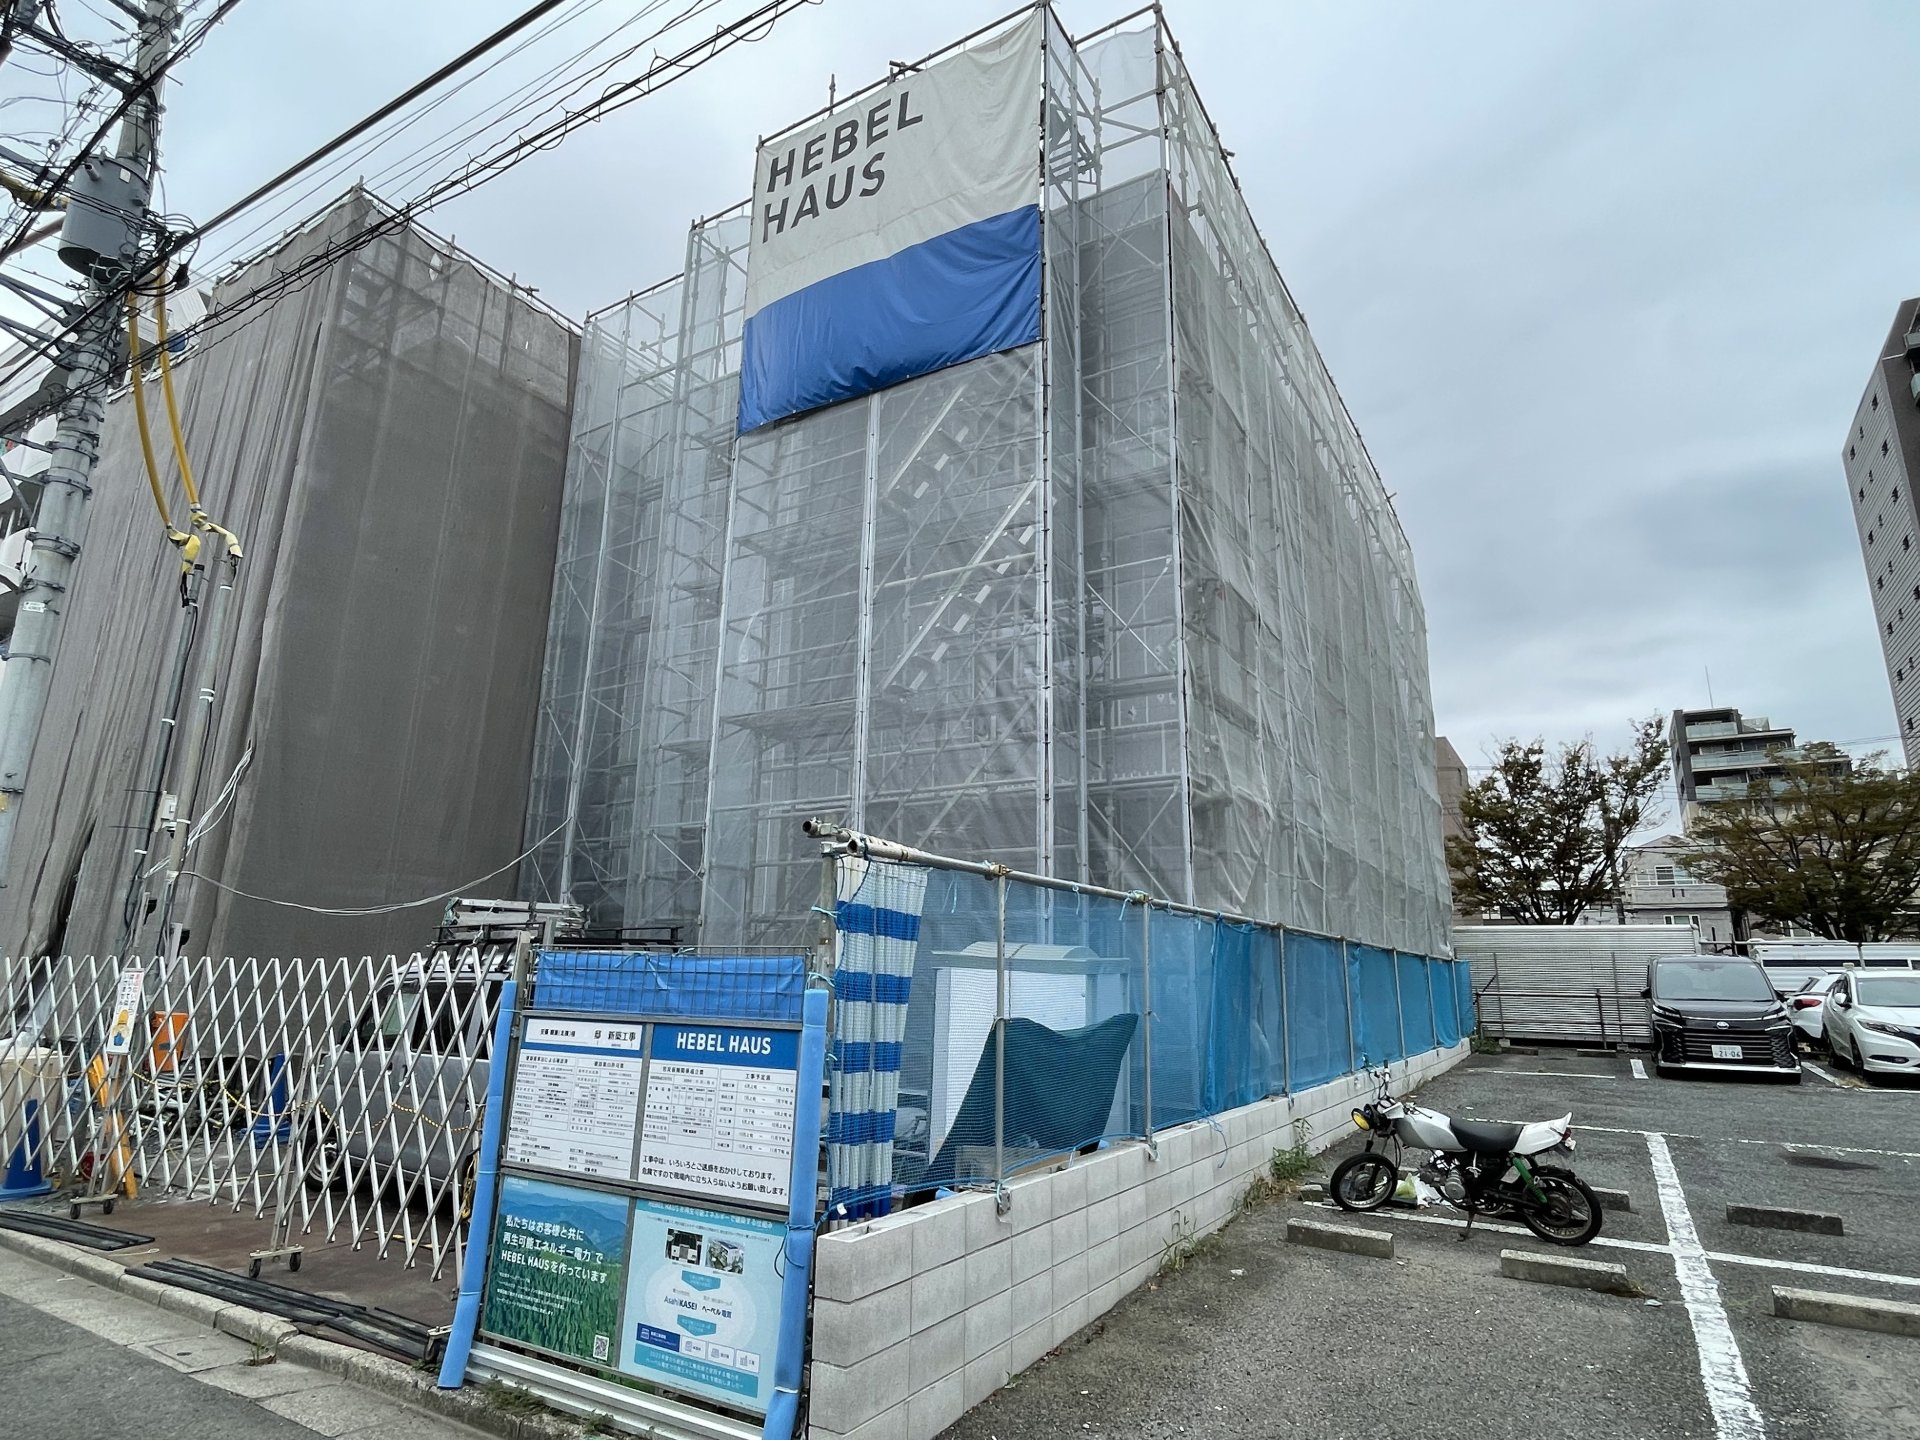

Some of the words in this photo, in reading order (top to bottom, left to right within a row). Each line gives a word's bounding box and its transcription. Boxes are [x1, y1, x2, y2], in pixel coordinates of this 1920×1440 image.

[767, 91, 923, 193] HEBEL
[762, 152, 885, 244] HAUS
[677, 1032, 725, 1052] HEBEL
[729, 1035, 771, 1055] HAUS
[505, 1215, 584, 1241] 私たちはお客様と共に
[501, 1250, 526, 1265] HEBEL
